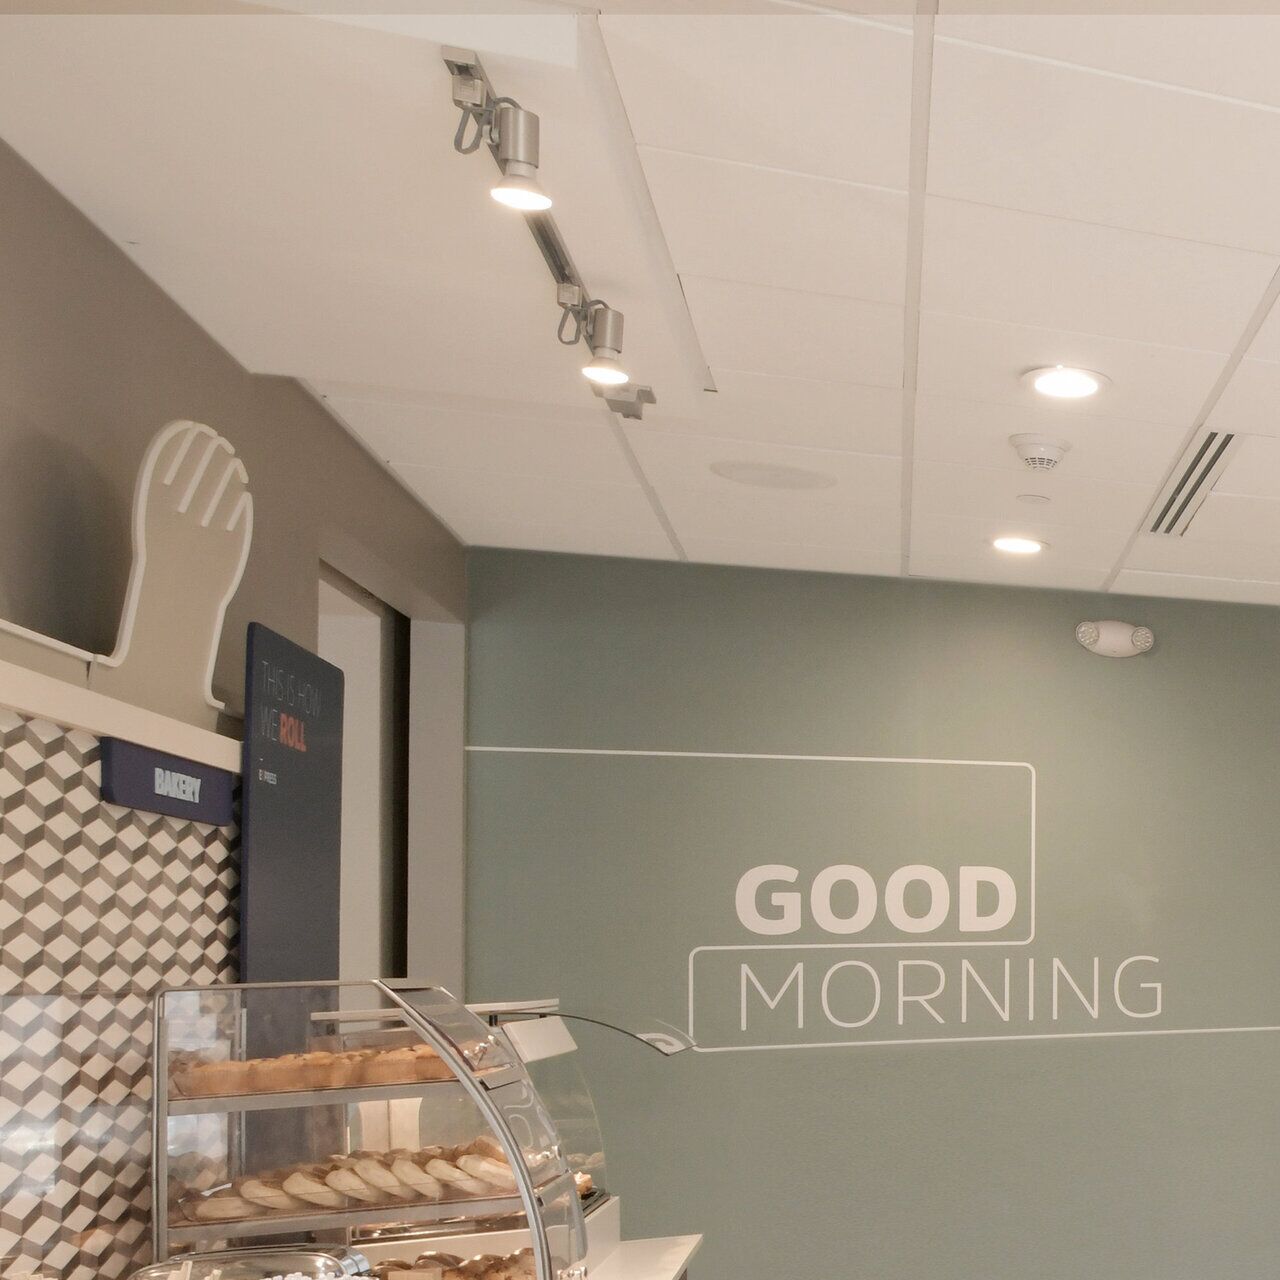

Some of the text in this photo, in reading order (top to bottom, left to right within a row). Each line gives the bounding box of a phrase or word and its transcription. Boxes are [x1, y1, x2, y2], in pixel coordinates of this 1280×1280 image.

[154, 767, 201, 803] BAKERY
[734, 863, 1018, 935] GOOD
[740, 955, 1163, 1031] MORNING
